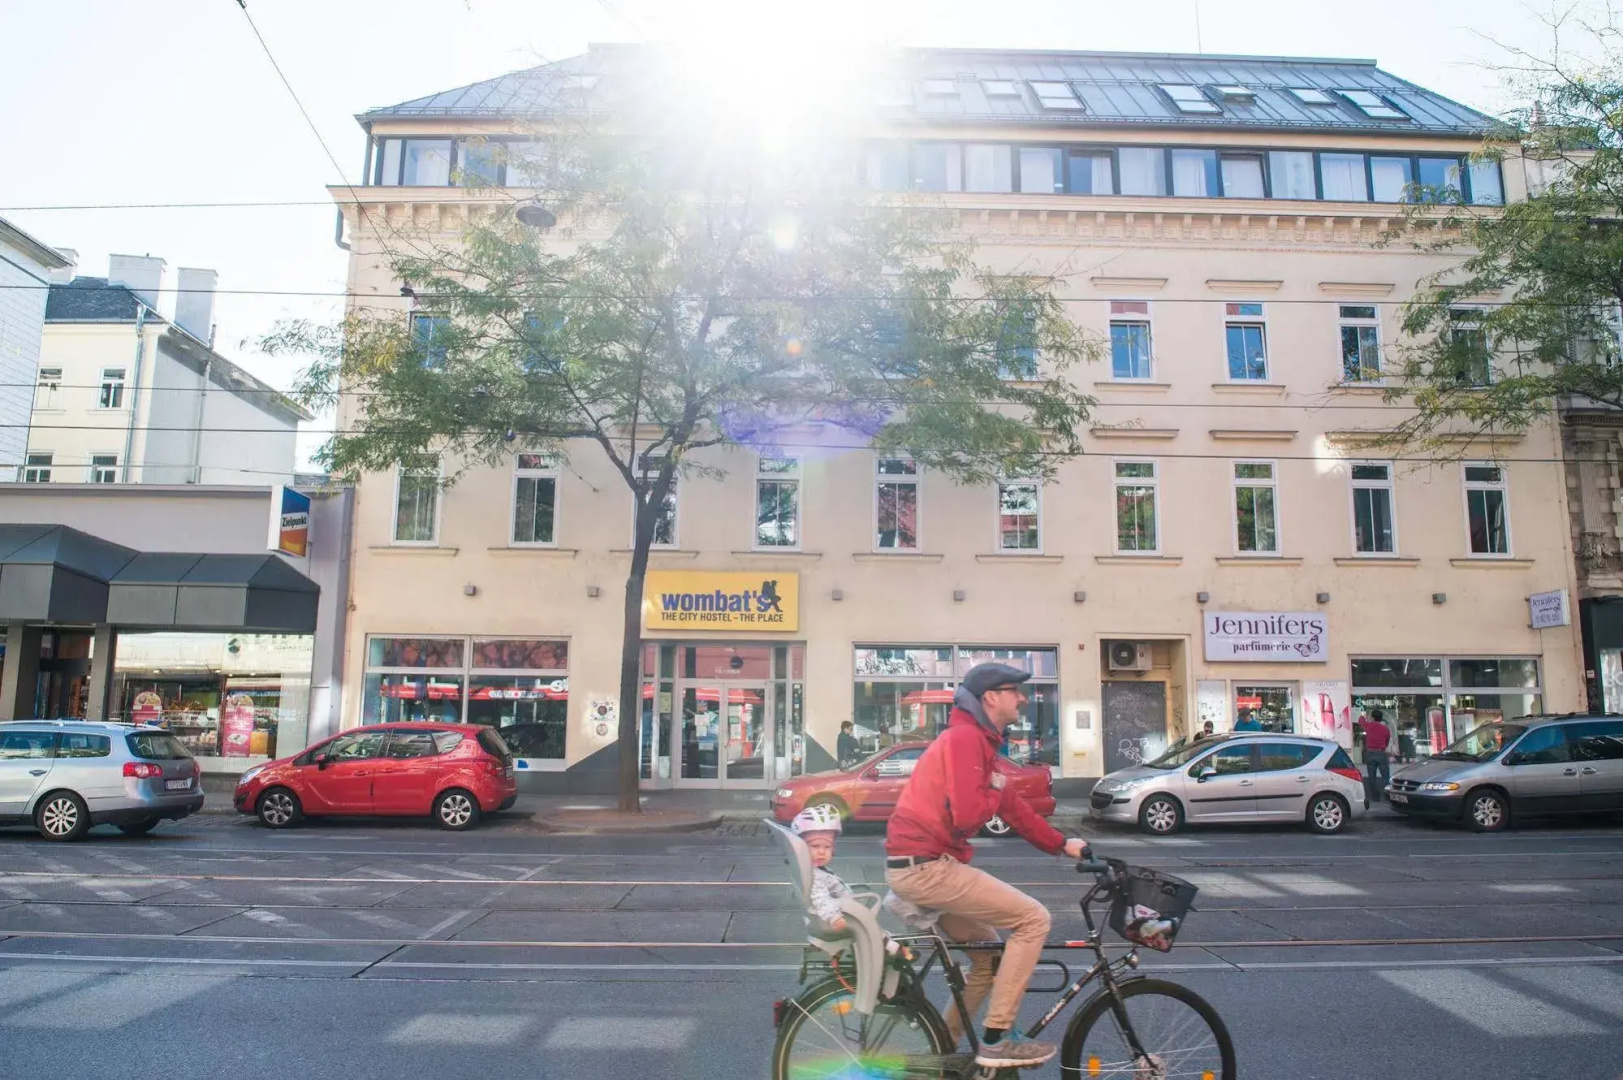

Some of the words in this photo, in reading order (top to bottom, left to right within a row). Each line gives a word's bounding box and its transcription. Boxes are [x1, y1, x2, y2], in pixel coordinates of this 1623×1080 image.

[661, 589, 771, 612] wombat's
[661, 612, 677, 621] THE
[678, 612, 698, 621] CITY
[700, 613, 732, 622] HOSTEL
[739, 613, 755, 622] THE
[757, 614, 784, 622] PLACE
[1210, 615, 1323, 635] Jennifers
[1233, 641, 1291, 653] parfümerie
